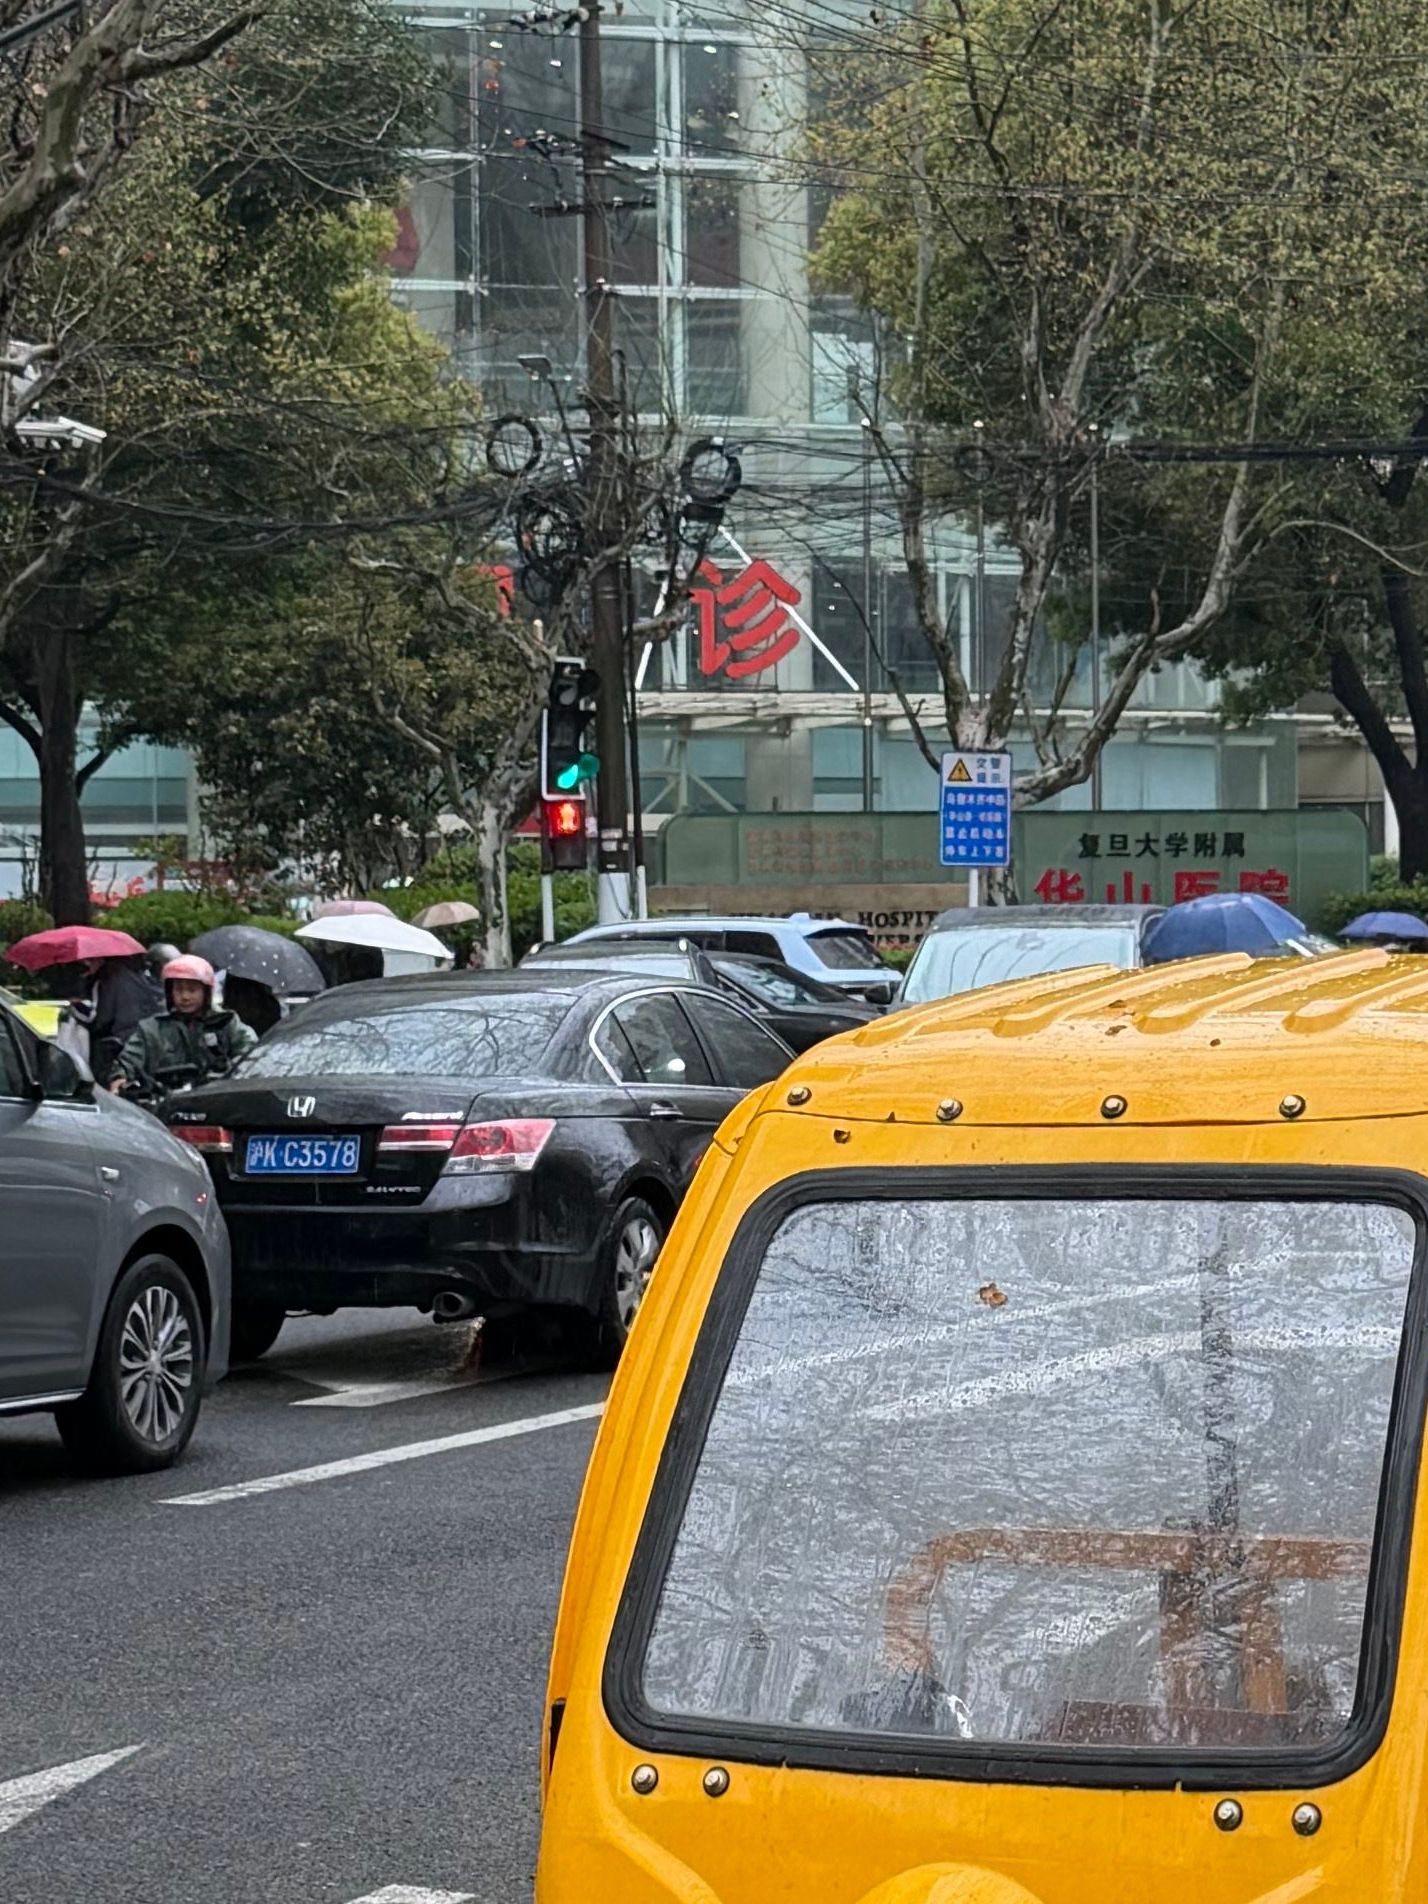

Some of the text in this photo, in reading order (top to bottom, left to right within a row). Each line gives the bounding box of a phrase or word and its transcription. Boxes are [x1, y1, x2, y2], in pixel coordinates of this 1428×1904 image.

[1078, 832, 1245, 859] 复旦大学附属
[1034, 868, 1290, 905] 华山医院
